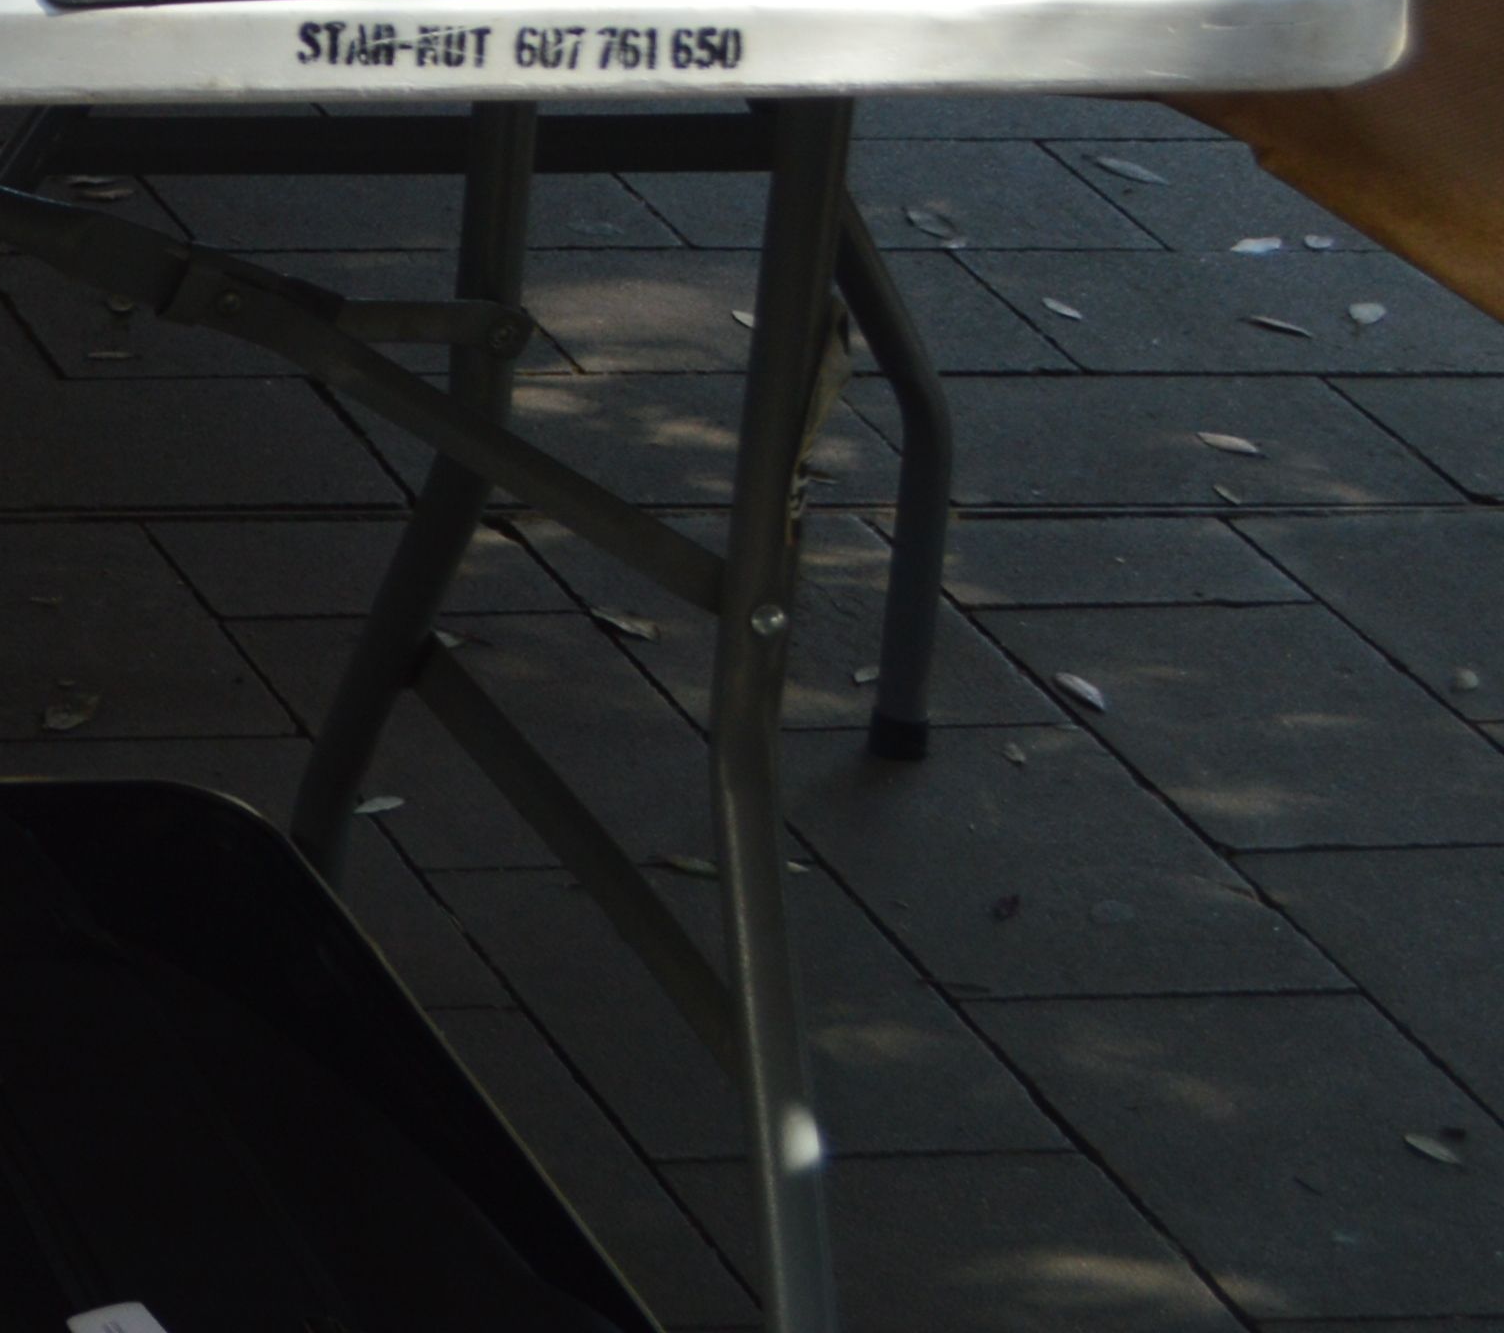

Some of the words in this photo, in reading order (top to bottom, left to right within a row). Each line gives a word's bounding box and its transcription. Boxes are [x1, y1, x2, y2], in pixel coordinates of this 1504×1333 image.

[515, 26, 586, 68] 607
[597, 27, 658, 69] 761
[671, 27, 742, 69] 650
